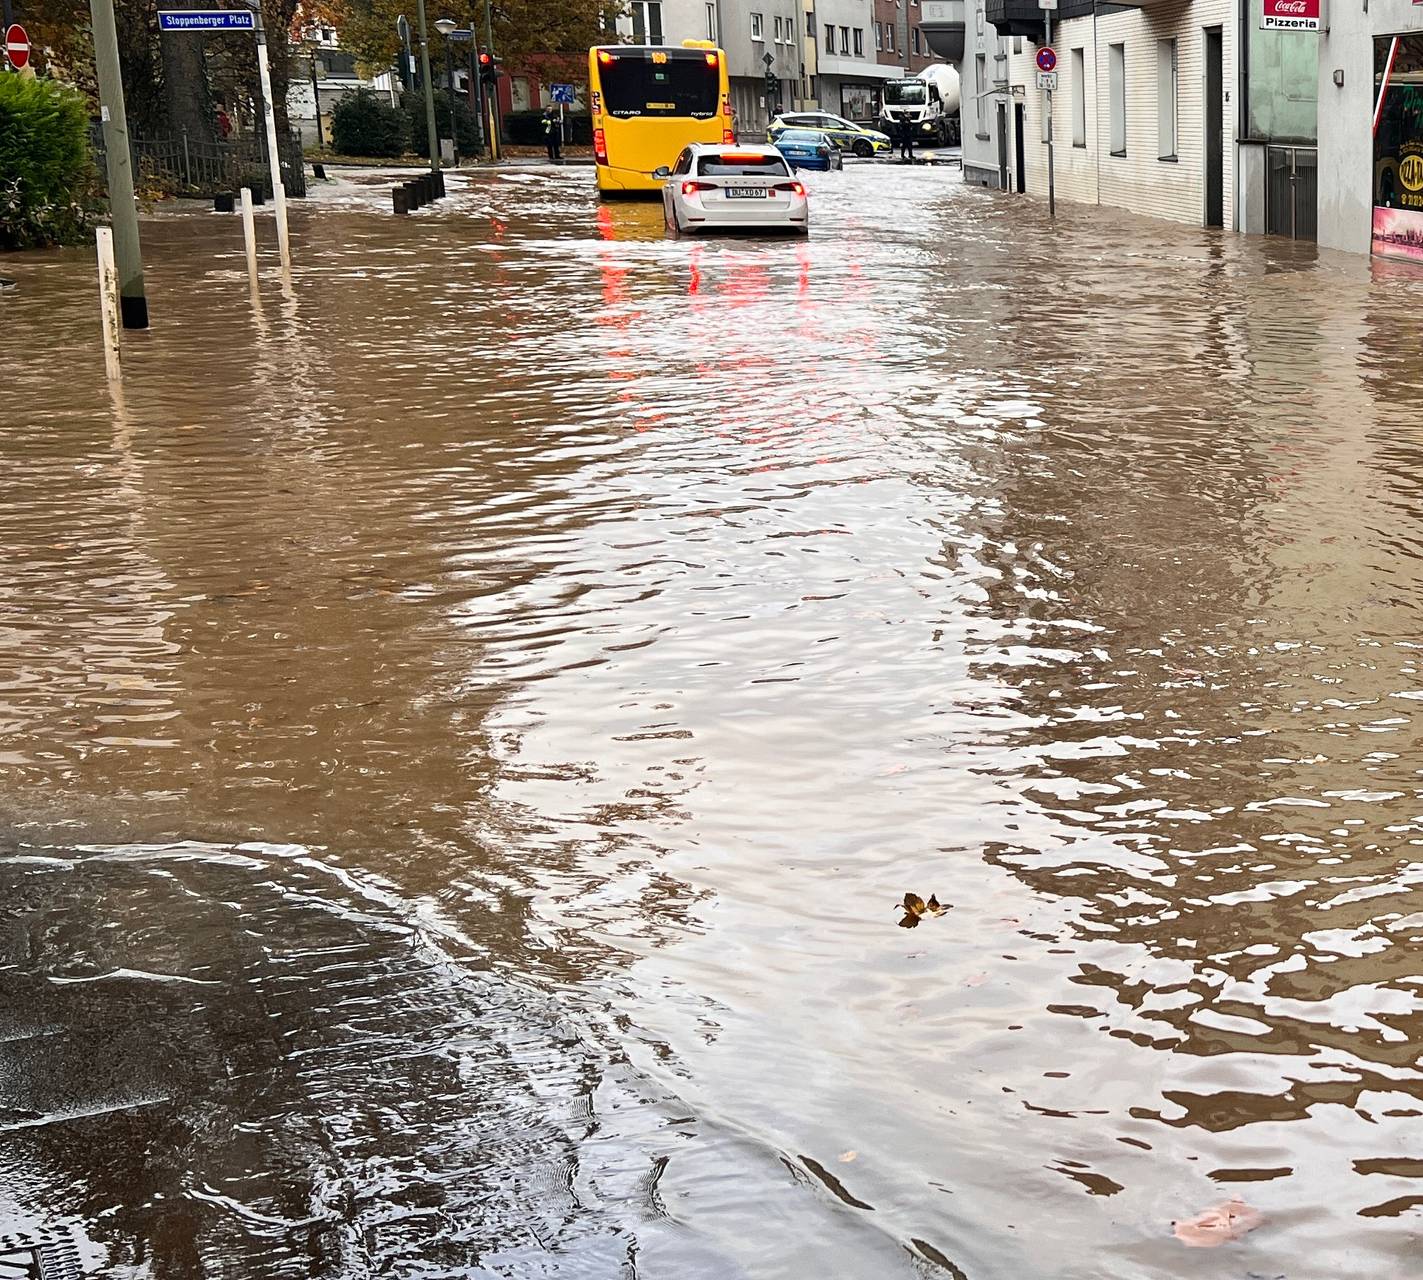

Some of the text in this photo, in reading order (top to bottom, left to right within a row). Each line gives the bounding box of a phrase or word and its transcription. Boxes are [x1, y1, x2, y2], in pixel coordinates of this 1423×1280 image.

[166, 15, 250, 27] Stoppenberger Platz
[1265, 17, 1317, 28] Pizzeria
